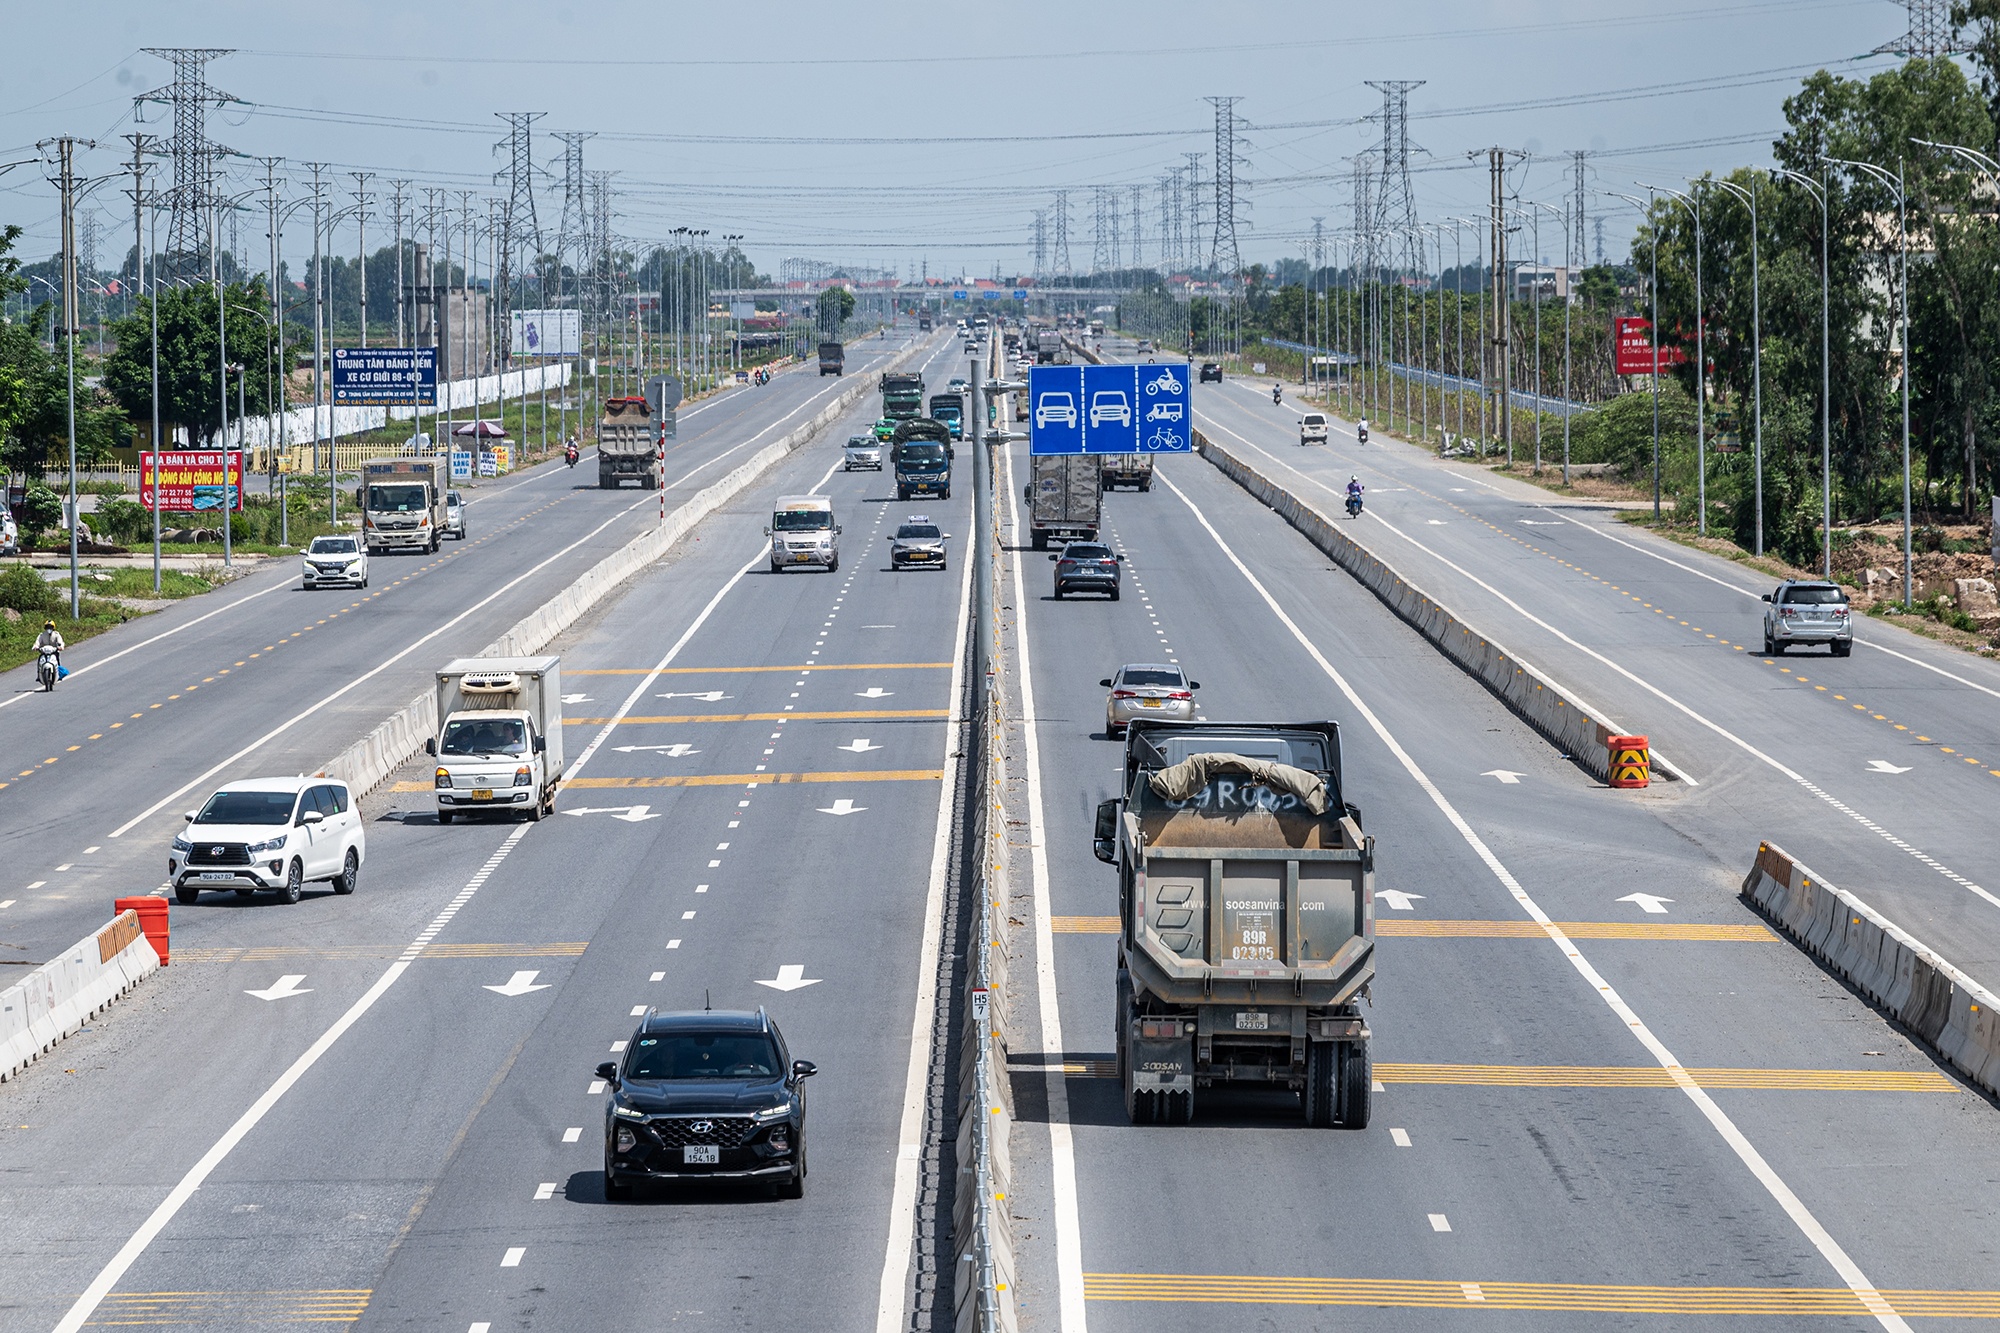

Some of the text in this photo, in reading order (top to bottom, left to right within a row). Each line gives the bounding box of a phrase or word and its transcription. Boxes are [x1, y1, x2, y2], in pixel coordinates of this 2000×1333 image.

[337, 359, 365, 369] TRUNG
[366, 357, 385, 369] TÂM
[386, 357, 409, 369] ĐĂNG
[347, 372, 358, 382] XE
[359, 372, 372, 382] CƠ
[373, 370, 390, 382] GIỚI
[145, 455, 164, 464] MA
[166, 454, 183, 465] BÁN
[185, 454, 197, 465] VÀ
[198, 455, 214, 465] CHO
[158, 468, 178, 489] ĐỘNG
[179, 466, 192, 485] SẢN
[193, 468, 212, 485] CÔNG
[1225, 899, 1285, 910] soosanvina
[1299, 900, 1325, 911] .com
[1242, 930, 1267, 945] 89R
[1232, 946, 1274, 960] 023.05
[974, 994, 987, 1004] H5
[978, 1006, 984, 1015] 7
[1245, 1013, 1259, 1021] 89R
[1141, 1062, 1182, 1070] SOOSAN
[688, 1154, 716, 1163] 154.18
